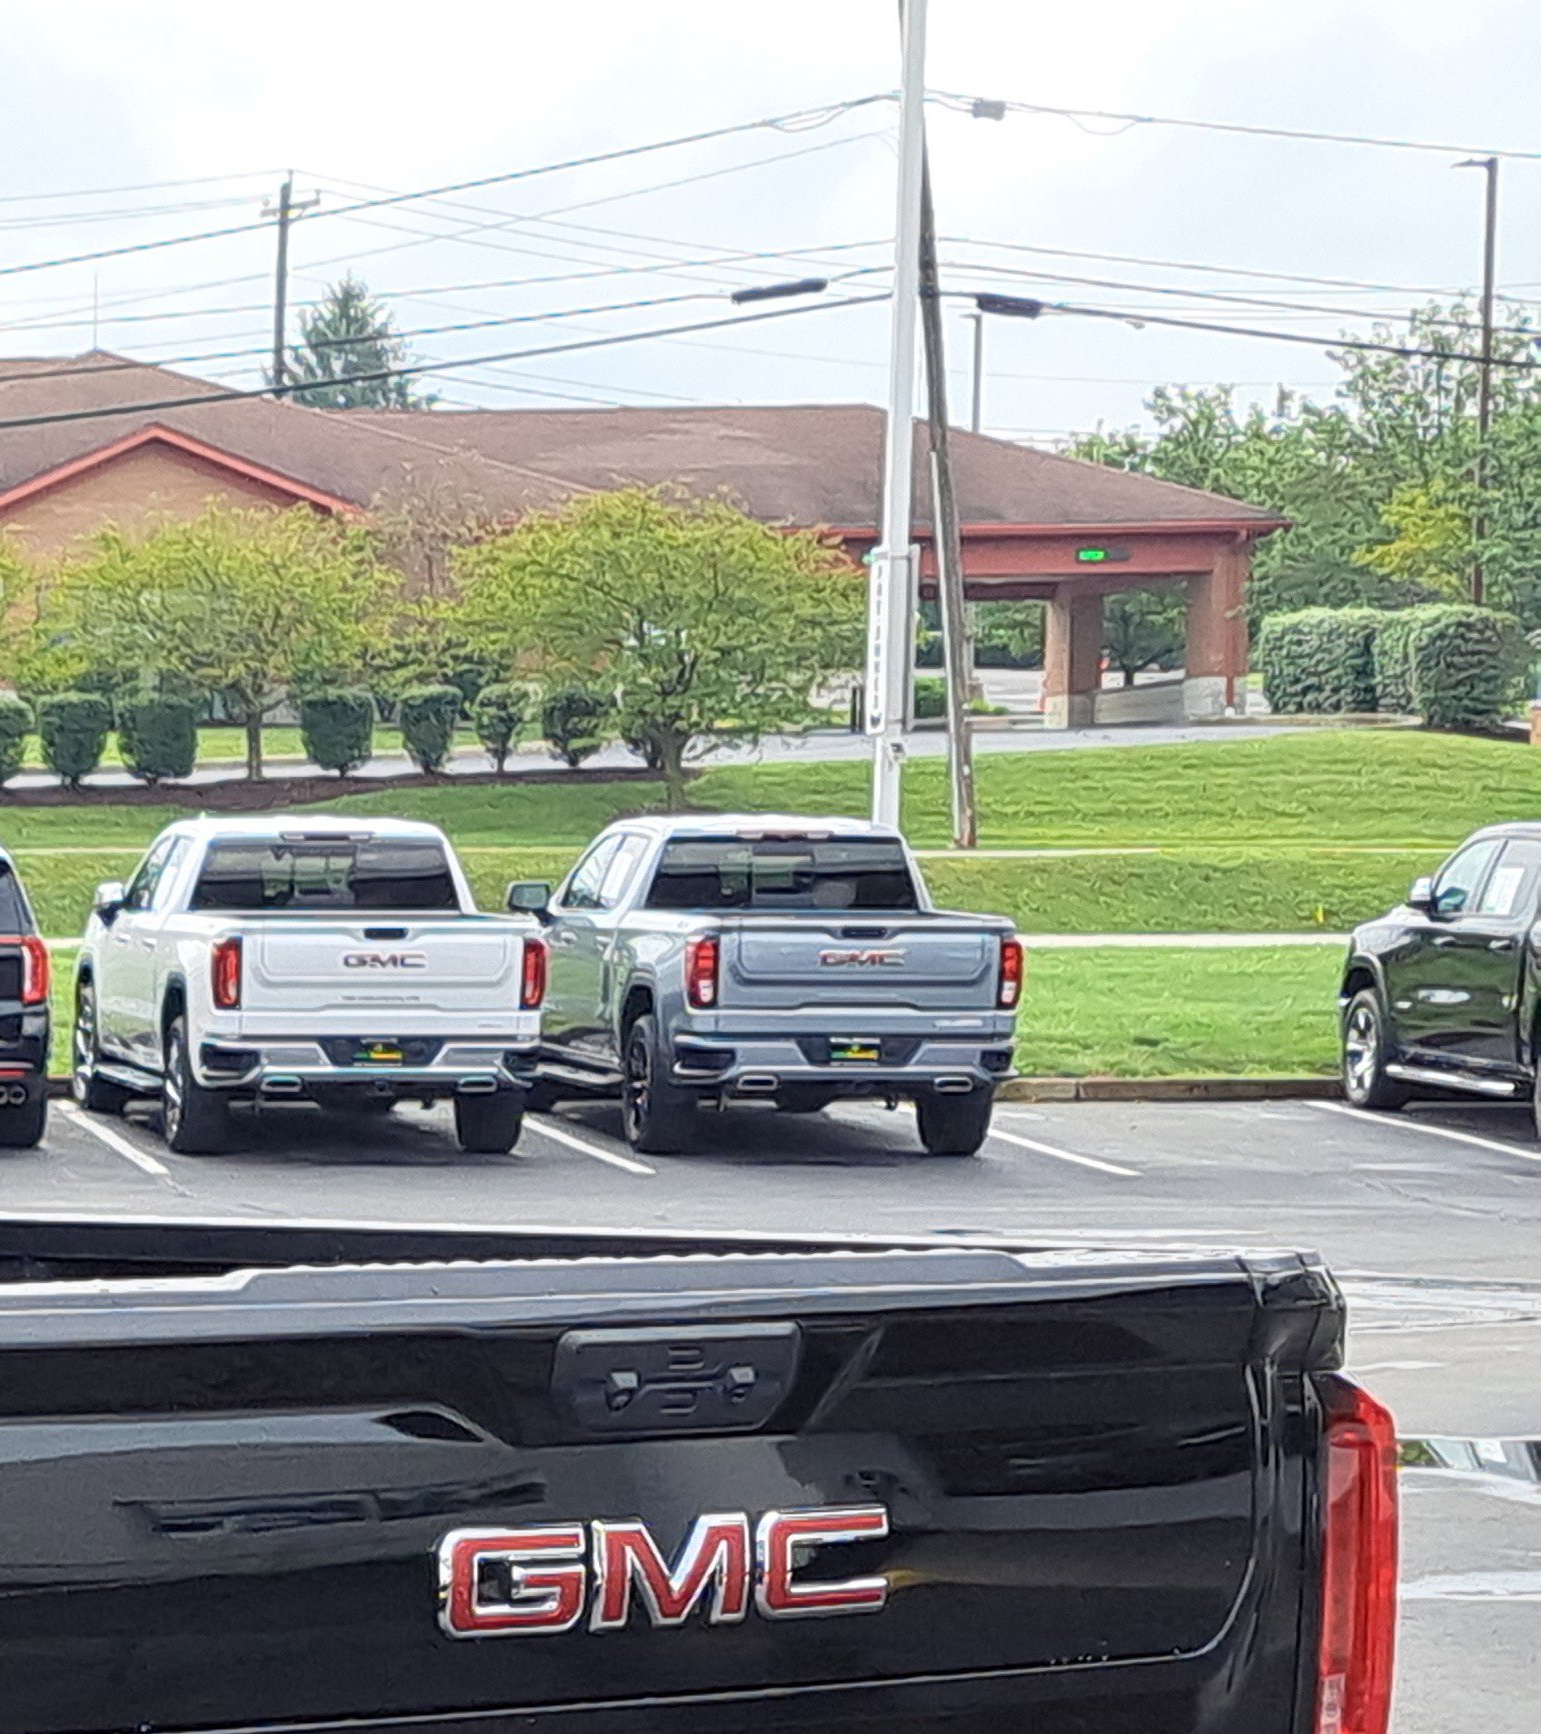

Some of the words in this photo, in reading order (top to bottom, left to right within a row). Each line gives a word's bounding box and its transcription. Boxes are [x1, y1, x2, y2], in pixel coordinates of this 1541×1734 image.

[341, 953, 426, 969] GMC
[818, 949, 905, 967] GMC
[437, 1503, 890, 1639] GMC
